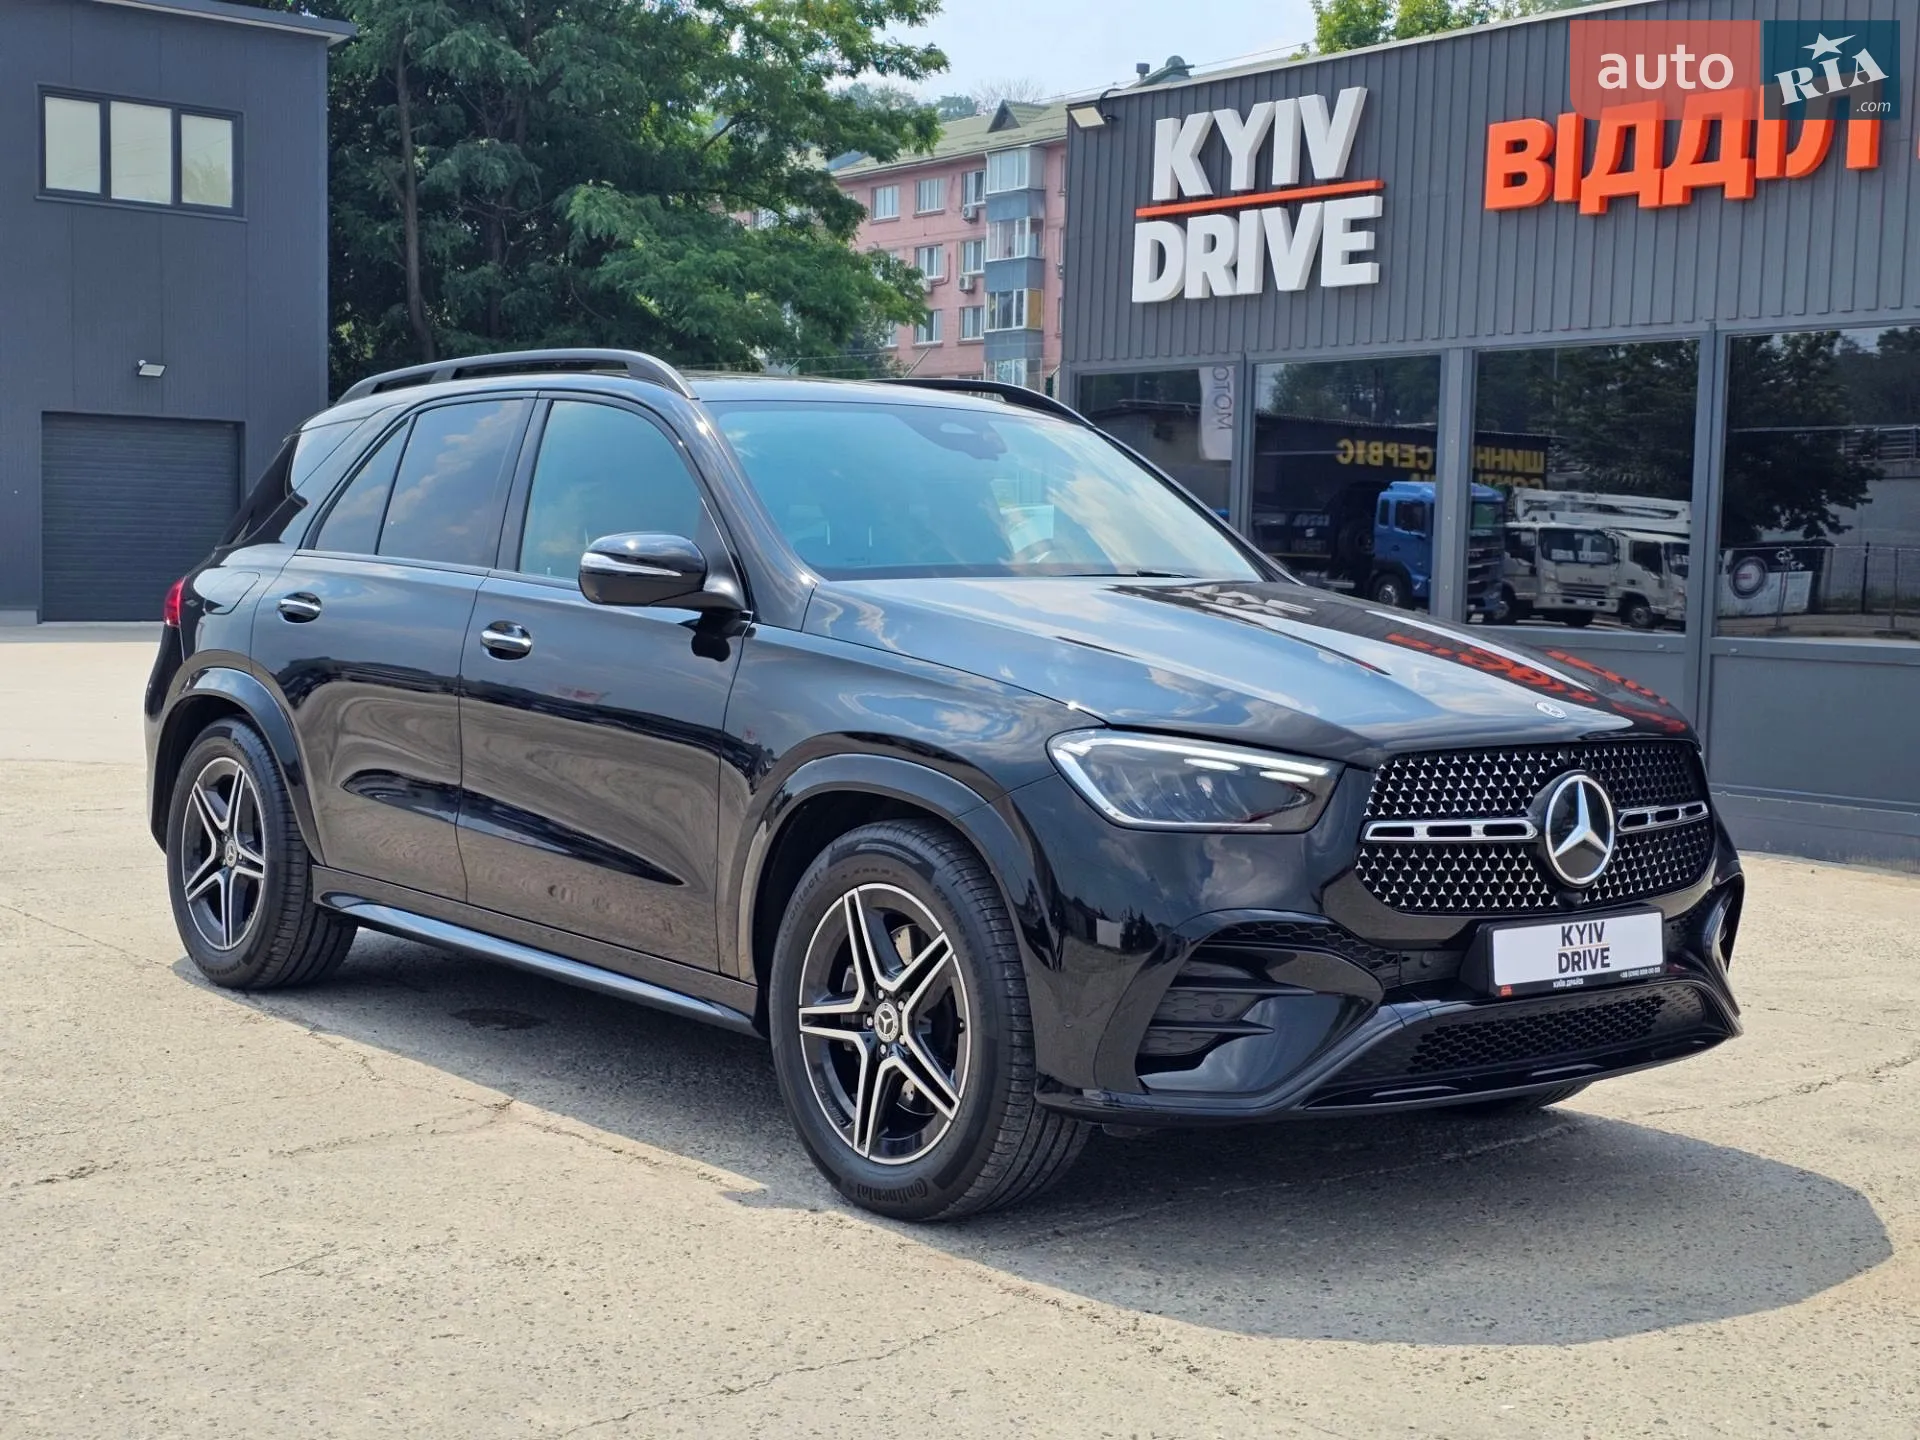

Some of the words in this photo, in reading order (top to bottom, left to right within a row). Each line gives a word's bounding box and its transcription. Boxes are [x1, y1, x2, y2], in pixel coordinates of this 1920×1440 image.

[1152, 86, 1369, 202] KYIV
[1131, 195, 1384, 304] DRIVE
[1558, 947, 1611, 974] DRIVE
[1561, 921, 1605, 947] KYIV
